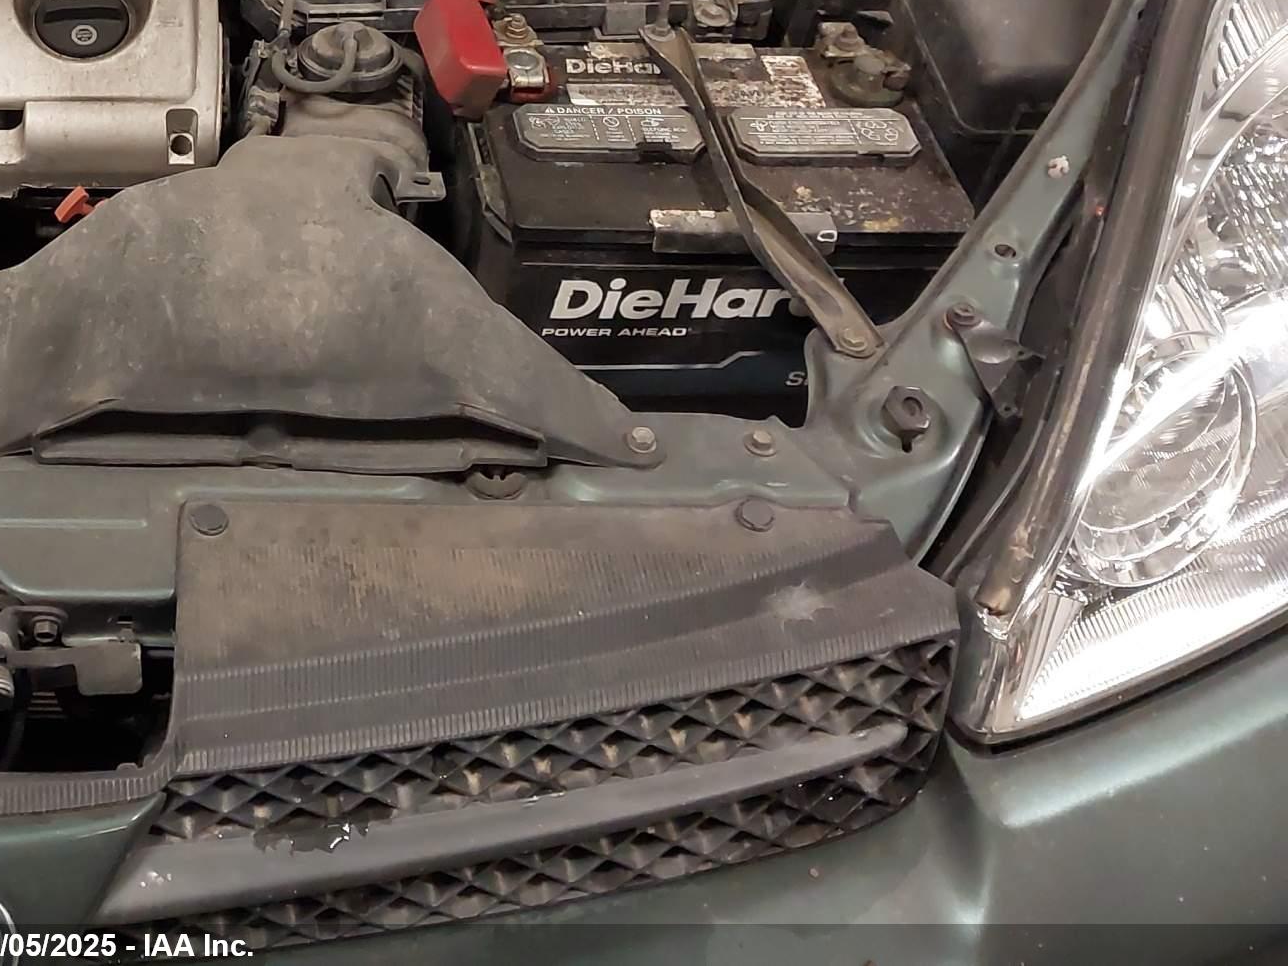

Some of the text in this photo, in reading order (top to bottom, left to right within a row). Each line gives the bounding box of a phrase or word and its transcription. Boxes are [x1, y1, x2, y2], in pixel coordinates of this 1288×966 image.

[556, 107, 605, 115] DANGER
[616, 107, 662, 115] POISON
[541, 327, 688, 337] POWER AHEAD
